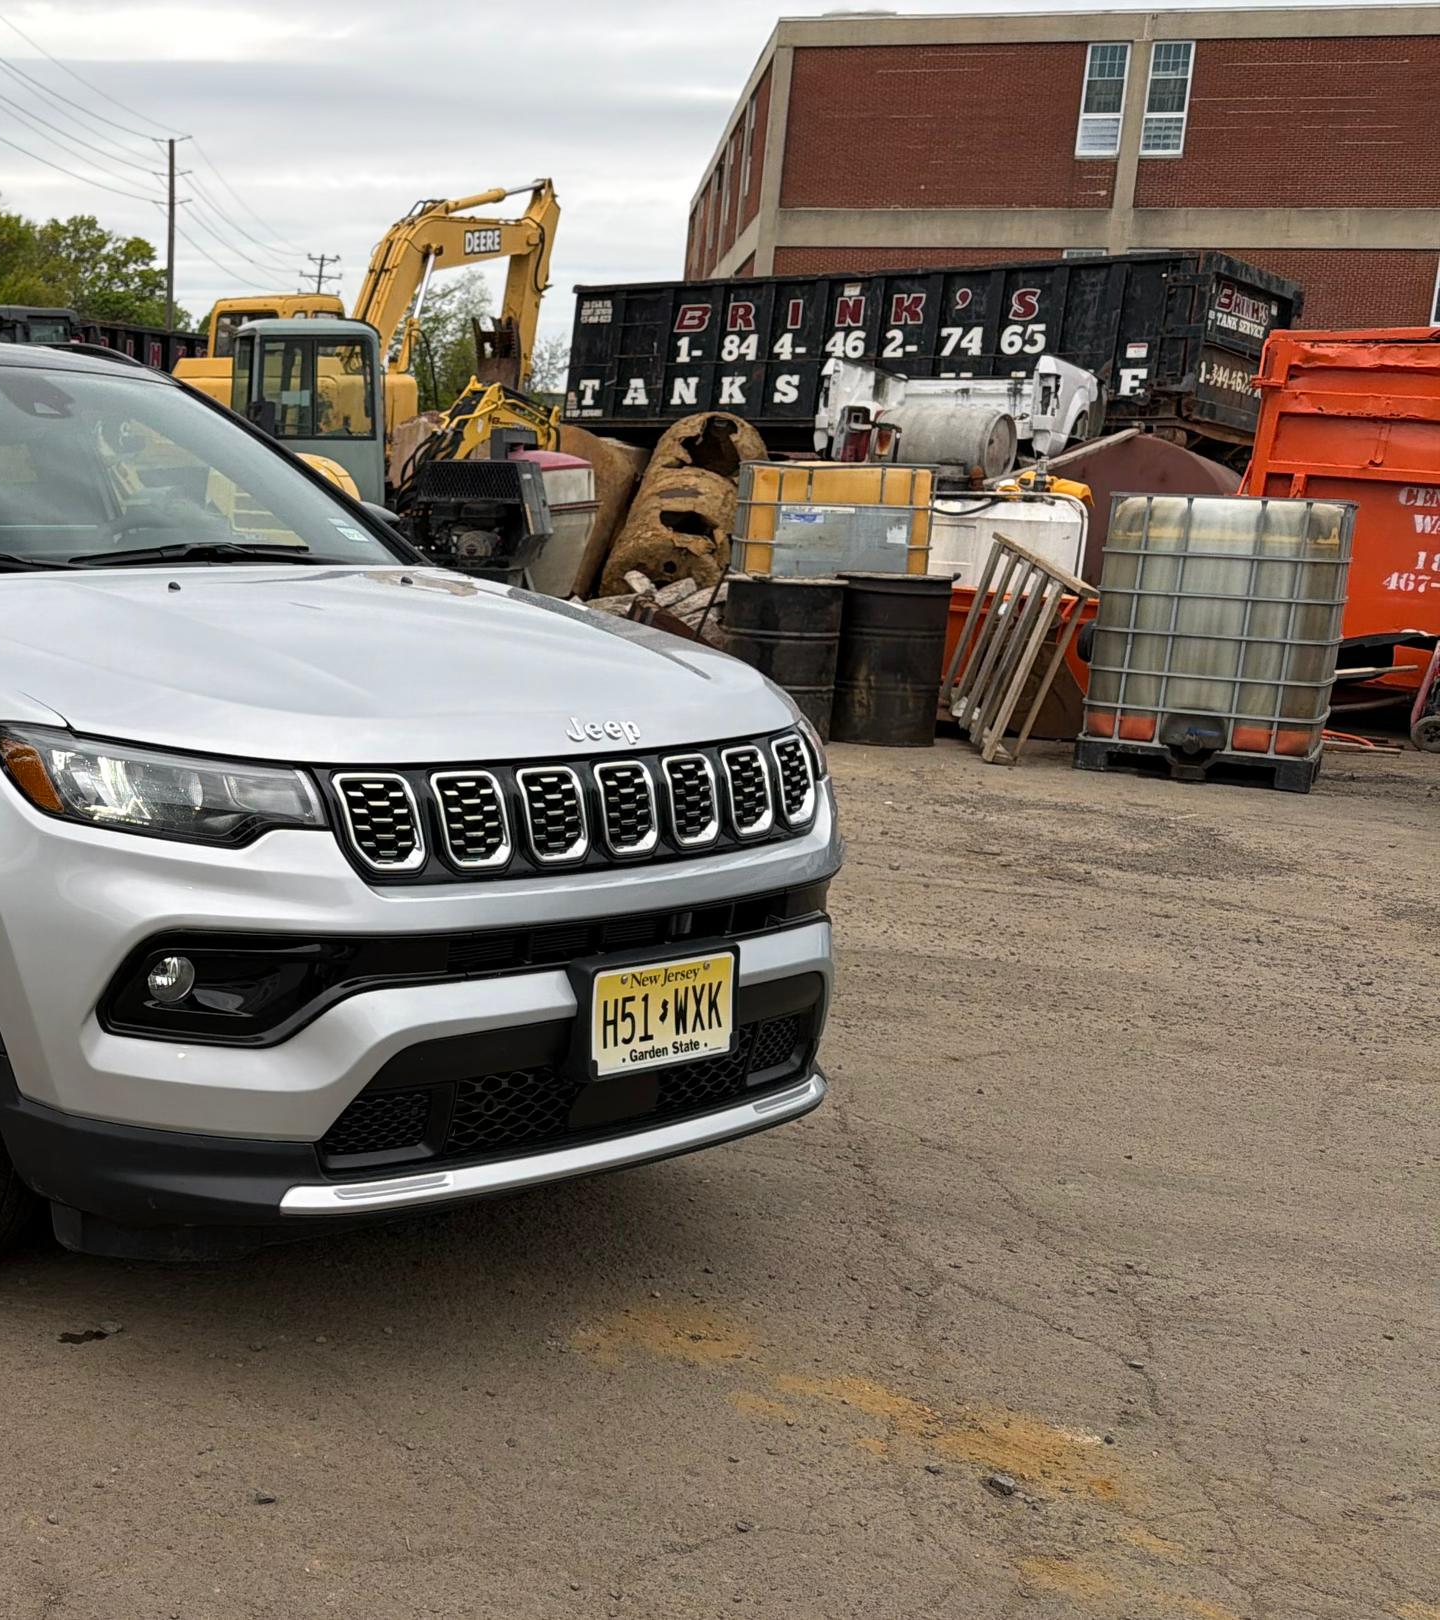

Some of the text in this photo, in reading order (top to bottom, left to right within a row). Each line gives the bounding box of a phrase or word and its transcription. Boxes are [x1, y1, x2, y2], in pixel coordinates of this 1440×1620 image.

[465, 230, 500, 253] DEERE
[1216, 312, 1239, 331] TANK
[566, 716, 640, 745] Jeep
[630, 966, 701, 989] New Jersey
[630, 1038, 700, 1062] Garden State
